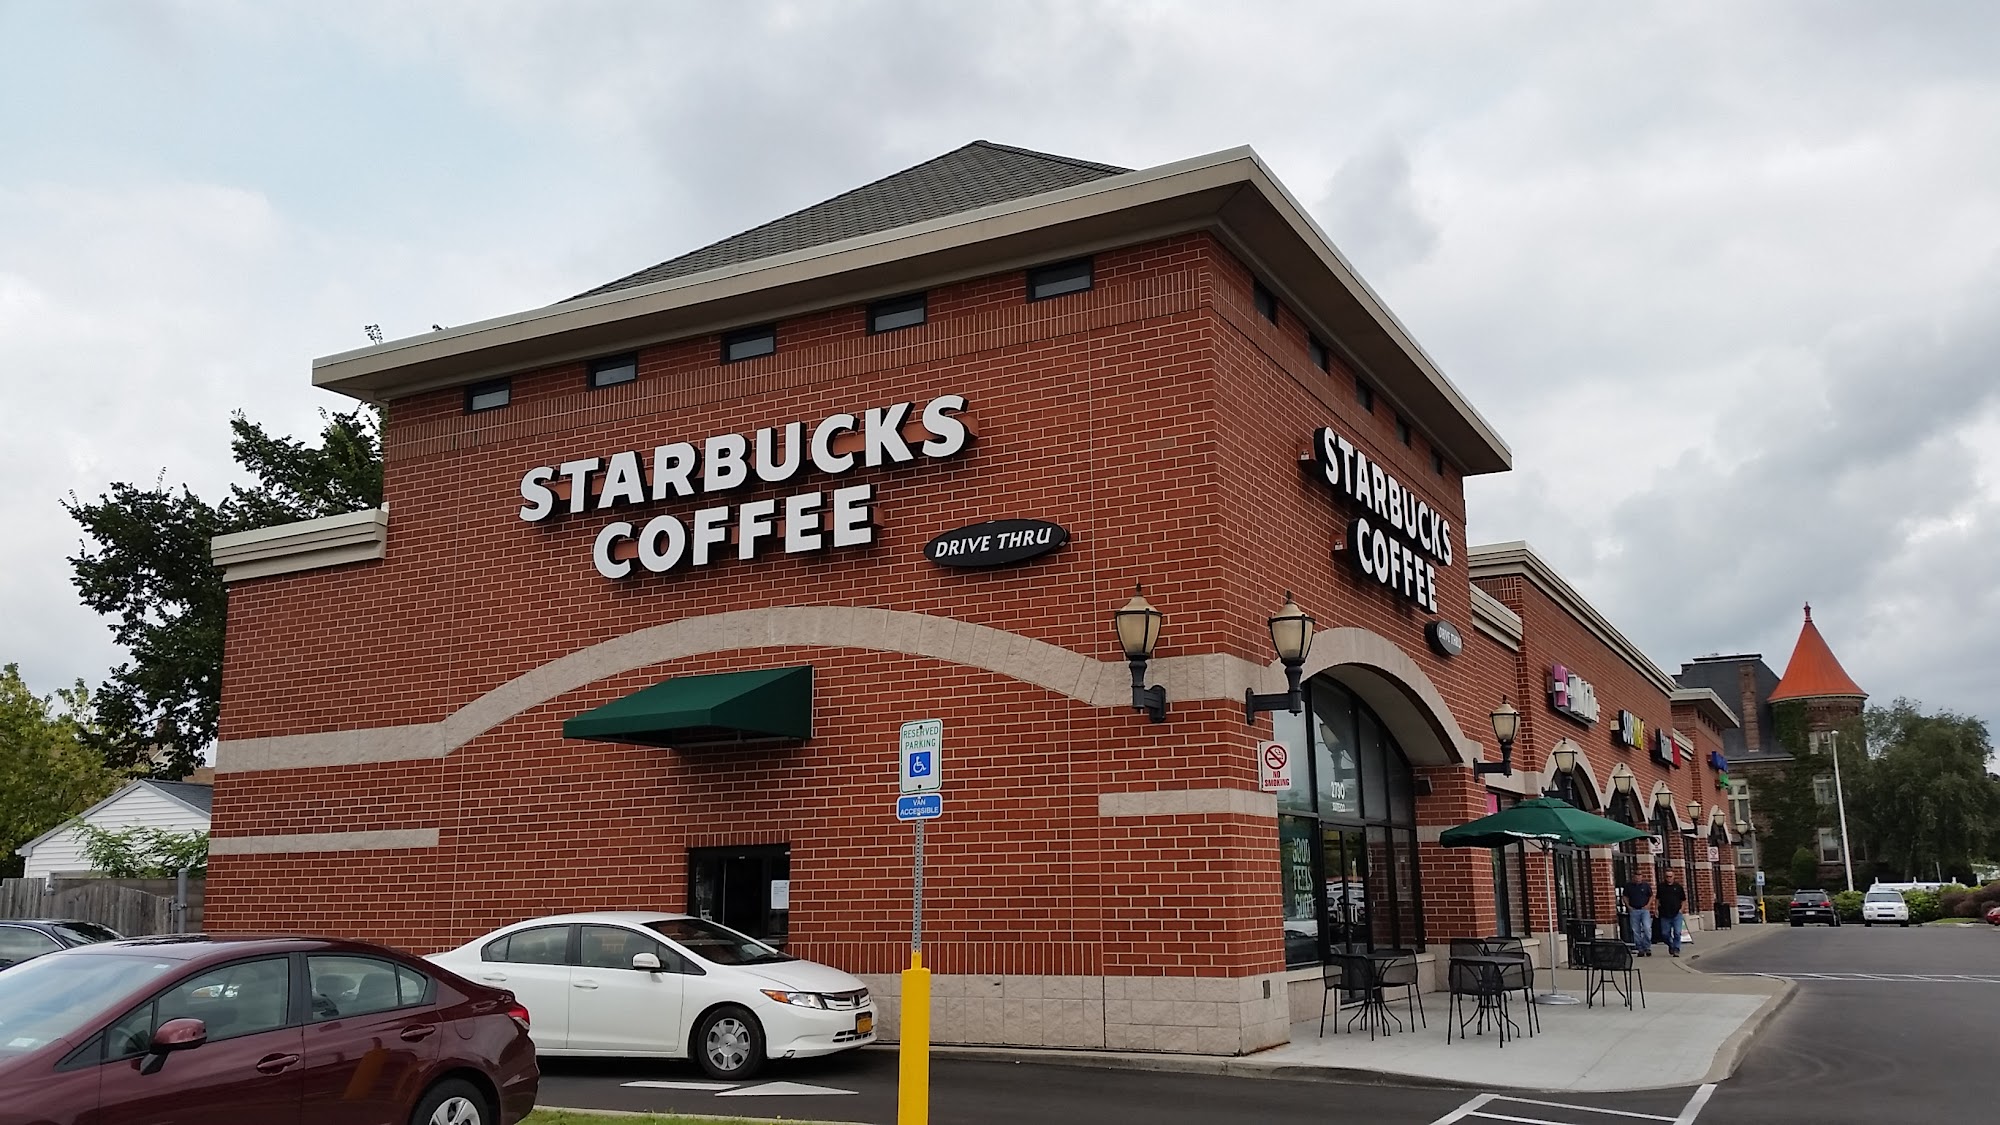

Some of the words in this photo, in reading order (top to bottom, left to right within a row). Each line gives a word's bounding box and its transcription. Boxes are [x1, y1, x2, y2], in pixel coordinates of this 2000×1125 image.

[519, 394, 969, 522] STARBUCKS
[1324, 426, 1452, 567] STARBUCKS
[593, 484, 873, 579] COFFEE
[934, 535, 992, 558] DRIVE
[996, 527, 1053, 550] THRU
[1357, 517, 1438, 614] COFFEE
[903, 726, 939, 739] RESERVED
[905, 738, 936, 750] PARKING
[1264, 778, 1290, 787] SMOKING
[1272, 770, 1281, 778] NO
[900, 806, 939, 816] ACCESSIBLE
